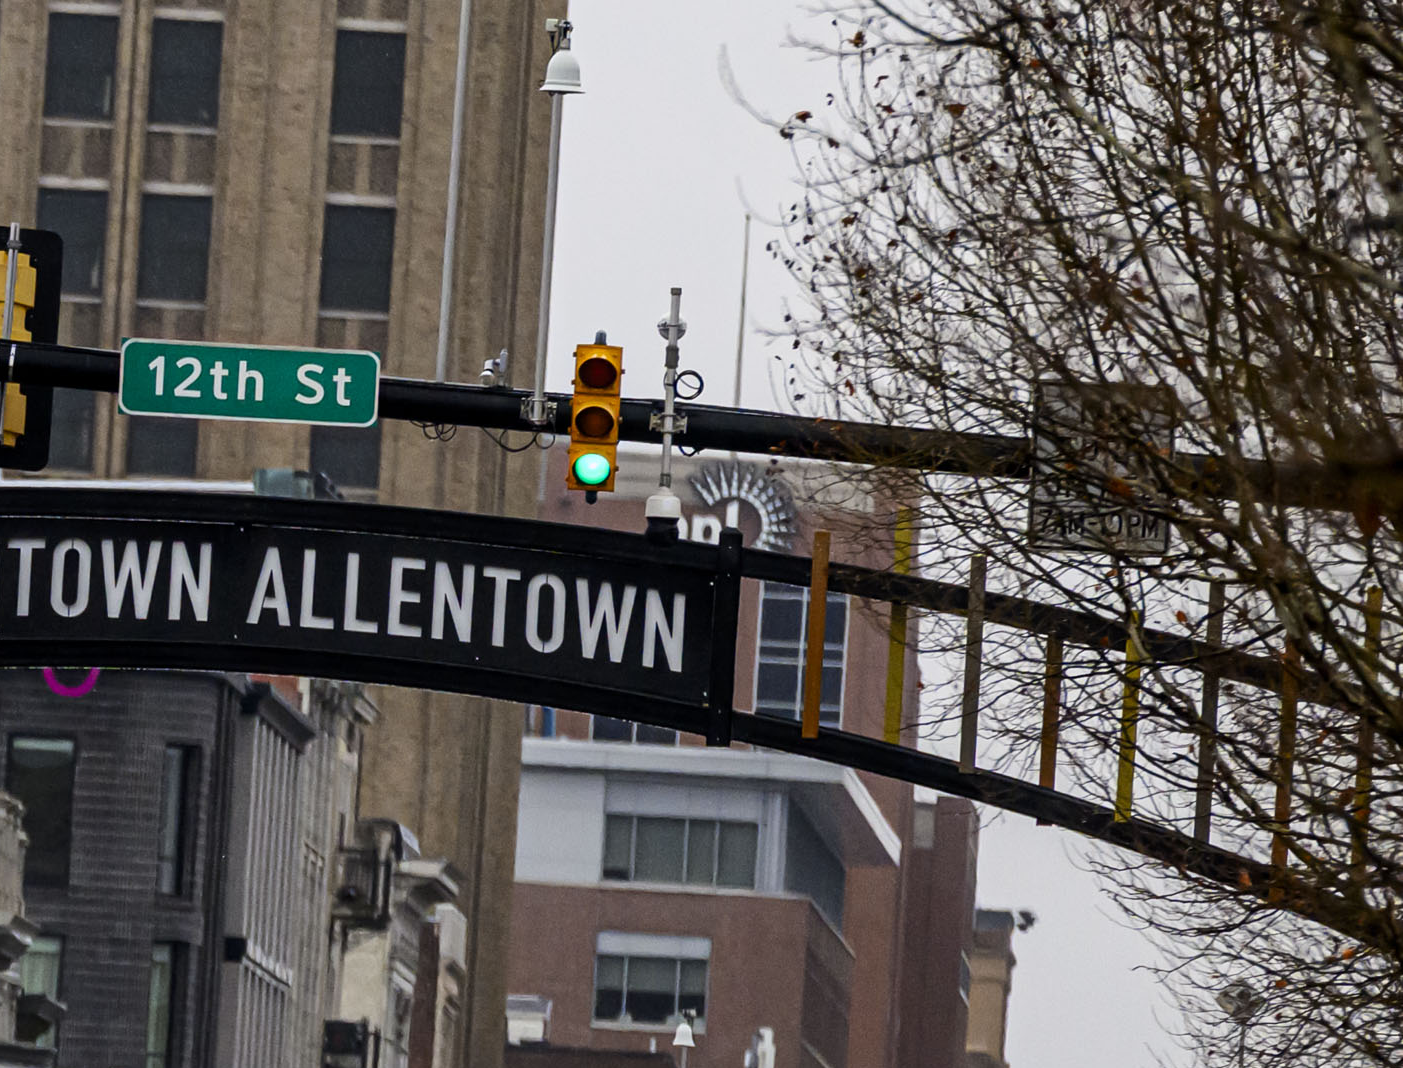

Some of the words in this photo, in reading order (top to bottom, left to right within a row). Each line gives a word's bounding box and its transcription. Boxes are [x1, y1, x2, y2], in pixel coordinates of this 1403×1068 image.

[148, 355, 265, 402] 12th
[295, 363, 353, 407] St
[245, 546, 687, 673] ALLENTOWN
